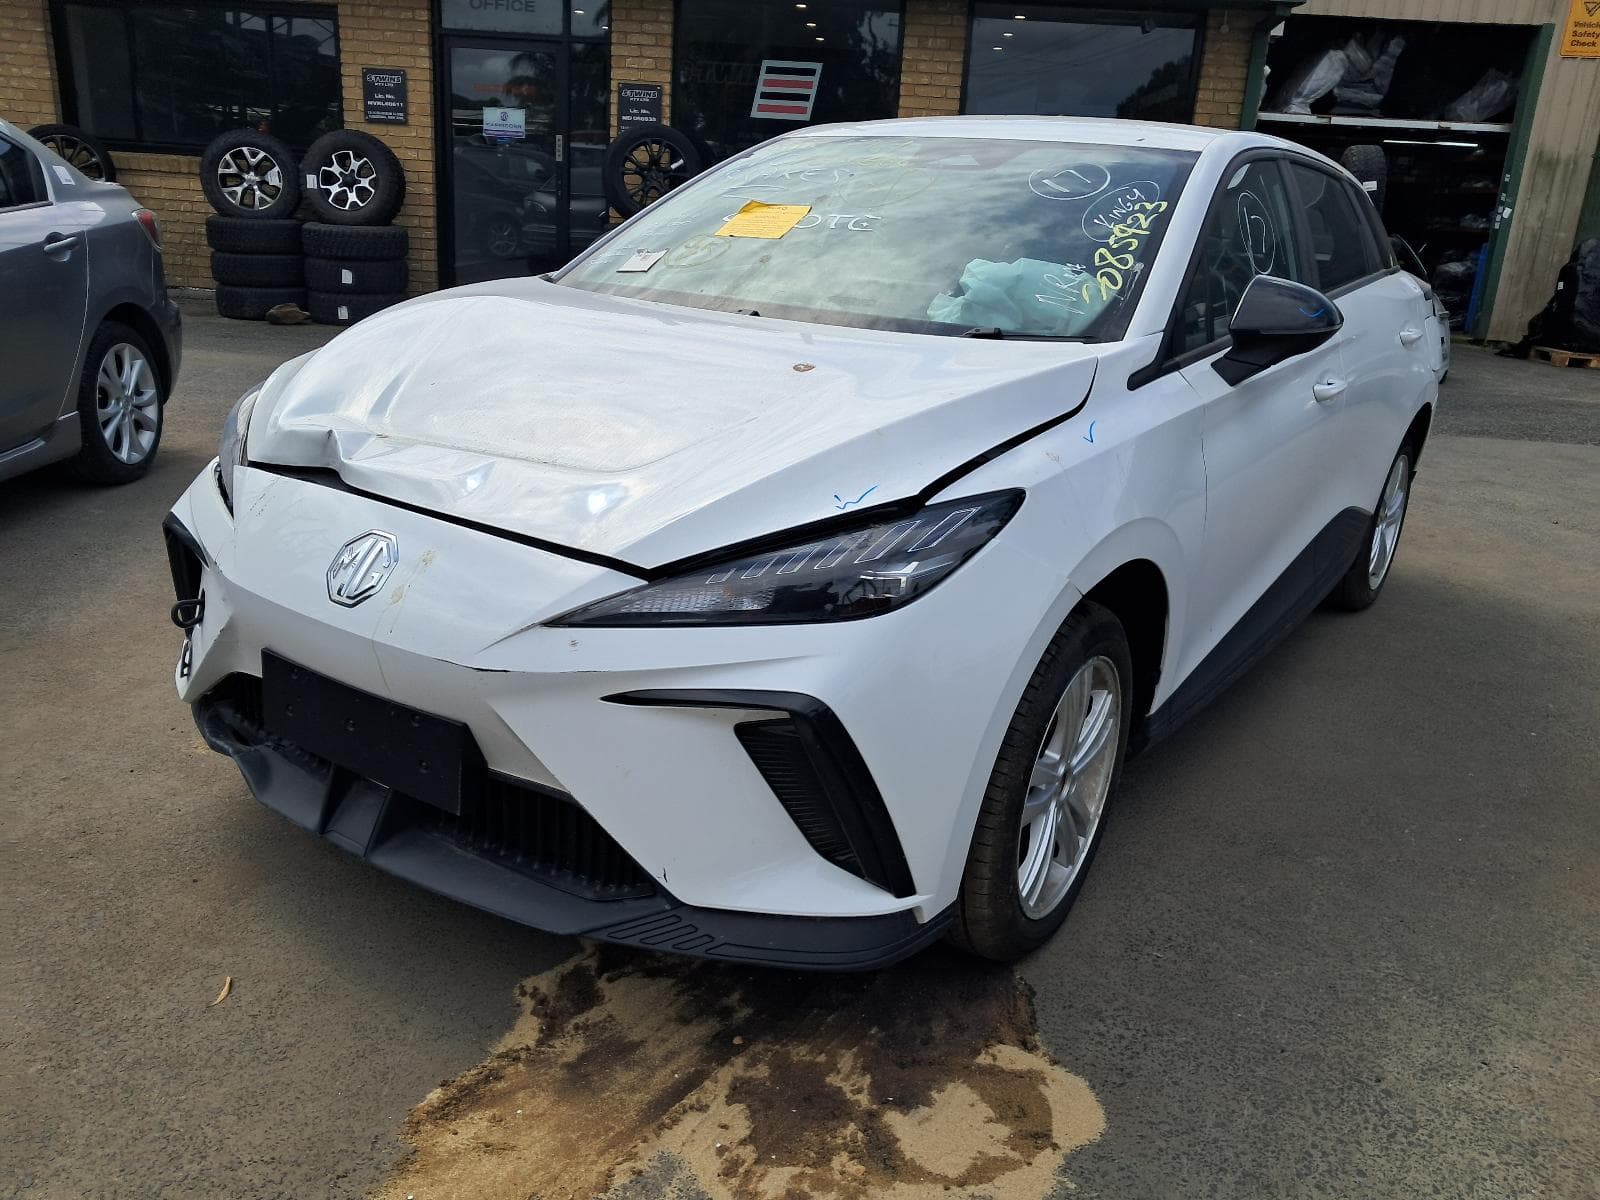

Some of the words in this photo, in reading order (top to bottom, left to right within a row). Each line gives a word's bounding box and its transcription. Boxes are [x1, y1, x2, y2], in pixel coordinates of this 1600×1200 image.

[469, 0, 536, 13] OFFICE
[1574, 21, 1600, 29] Vehicl
[1572, 30, 1600, 39] Safety
[1042, 169, 1092, 193] 17
[331, 536, 392, 601] MG
